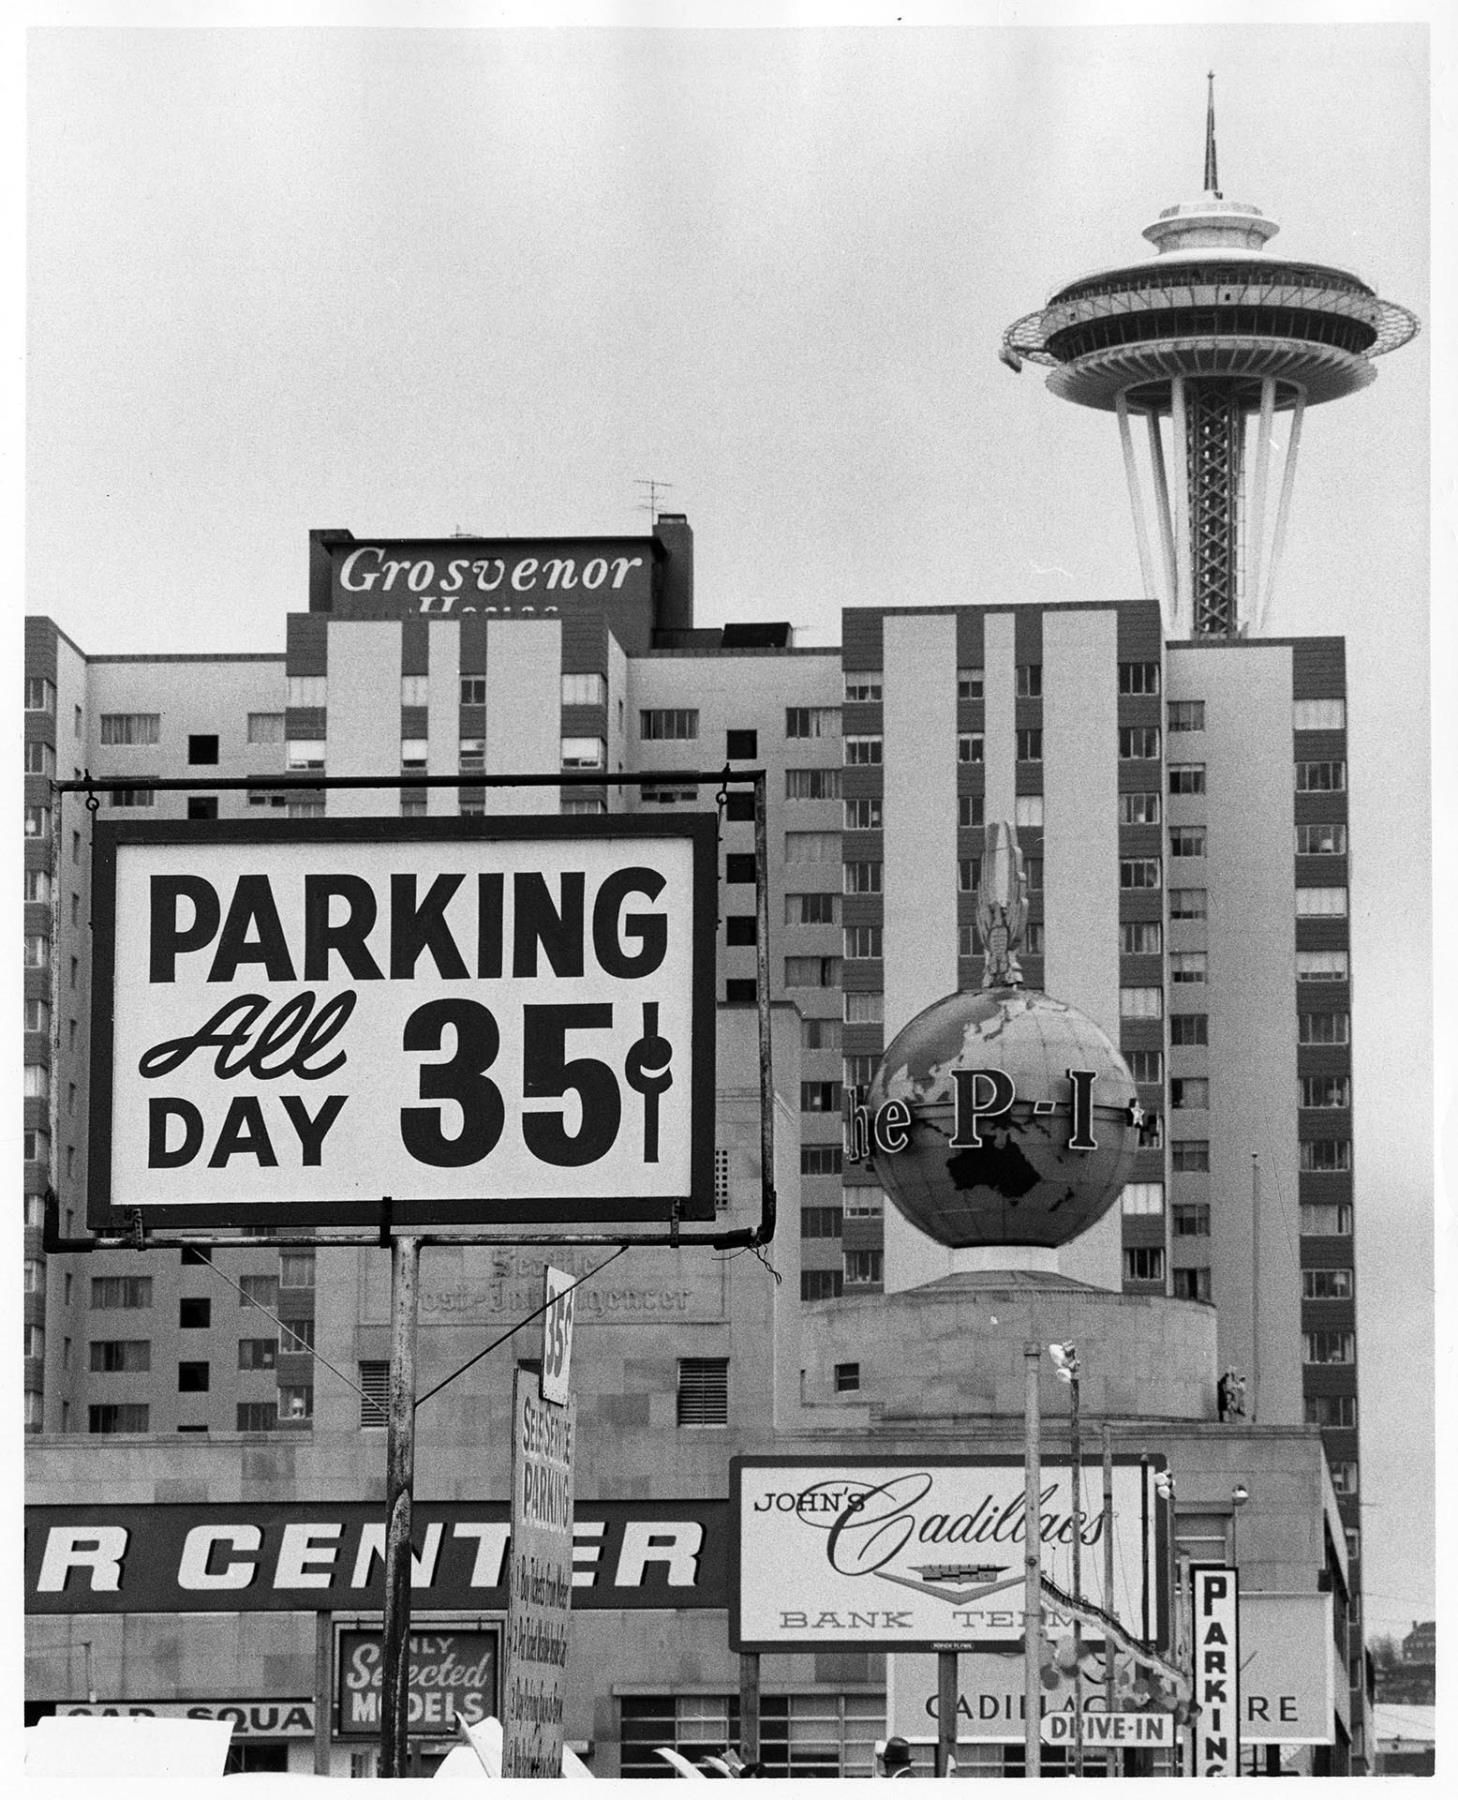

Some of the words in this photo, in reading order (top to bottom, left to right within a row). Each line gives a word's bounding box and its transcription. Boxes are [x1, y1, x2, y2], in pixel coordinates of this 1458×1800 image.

[340, 547, 643, 592] Grosvenor
[149, 866, 668, 984] PARKING
[138, 990, 357, 1080] All
[400, 998, 673, 1168] 35¢
[949, 1069, 1098, 1150] P-I
[148, 1095, 349, 1169] DAY
[524, 1462, 569, 1528] PARKING
[754, 1487, 866, 1512] JOHN'S
[797, 1473, 1107, 1576] Cadillacs
[178, 1521, 705, 1590] CENTER
[408, 1637, 454, 1654] NLY
[779, 1611, 913, 1628] BANK
[952, 1610, 1120, 1628] TEM
[347, 1643, 492, 1689] Seected
[352, 1692, 484, 1722] MDELS
